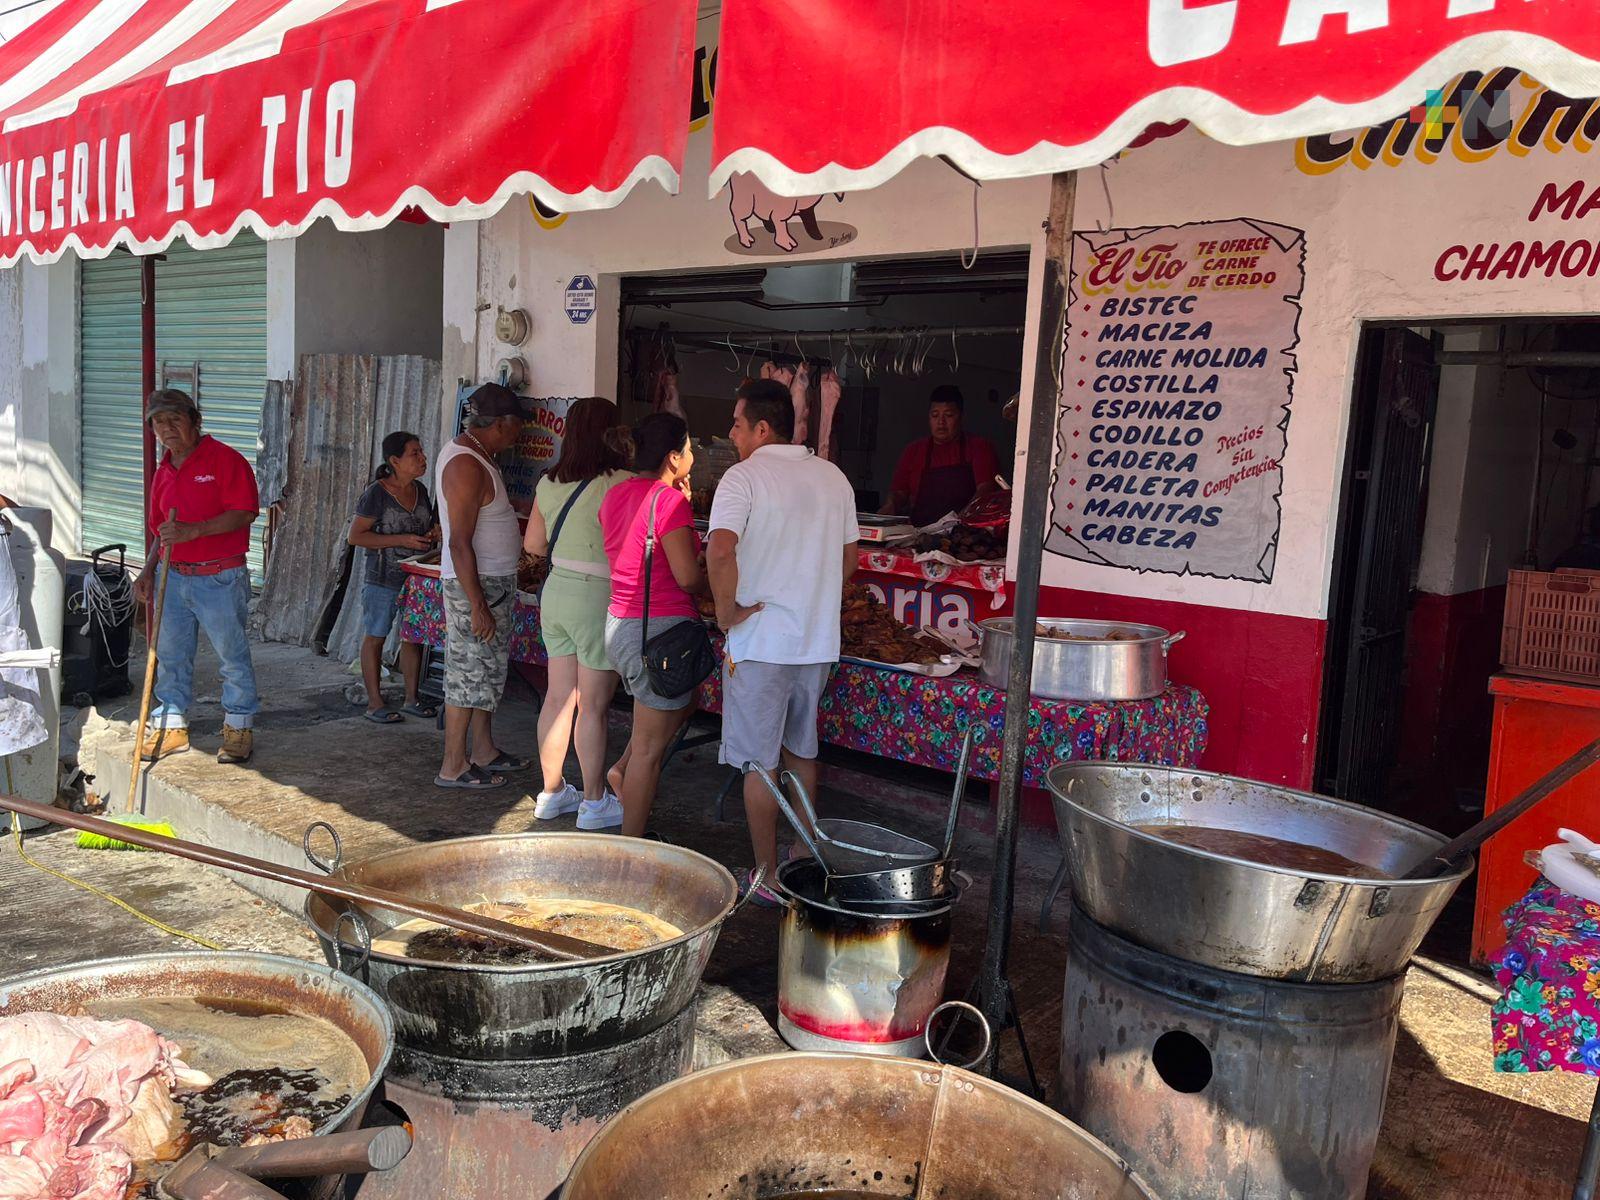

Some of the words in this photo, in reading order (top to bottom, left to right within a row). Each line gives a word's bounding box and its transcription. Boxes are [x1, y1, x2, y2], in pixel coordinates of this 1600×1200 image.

[166, 114, 215, 213] EL
[260, 79, 356, 199] TIO
[1198, 241, 1217, 256] TE
[1219, 236, 1272, 254] OFRECE
[1088, 247, 1135, 286] El
[1202, 256, 1260, 271] CARNE
[1187, 275, 1210, 288] DE
[1215, 271, 1277, 287] CERDO
[1100, 295, 1198, 317] BISTEC
[1097, 321, 1213, 342] MACIZA
[1095, 348, 1167, 369] CARNE
[1171, 347, 1268, 369] MOLIDA
[1092, 374, 1219, 393] COSTILLA
[1091, 400, 1223, 422] ESPINAZO
[1089, 424, 1204, 446] CODILLO
[1217, 425, 1264, 454] Precios
[1087, 450, 1198, 472] CADERA
[1085, 474, 1200, 498] PALETA
[1202, 455, 1278, 498] Competencia
[1082, 498, 1223, 527] MANITAS
[1080, 524, 1197, 549] CABEZA
